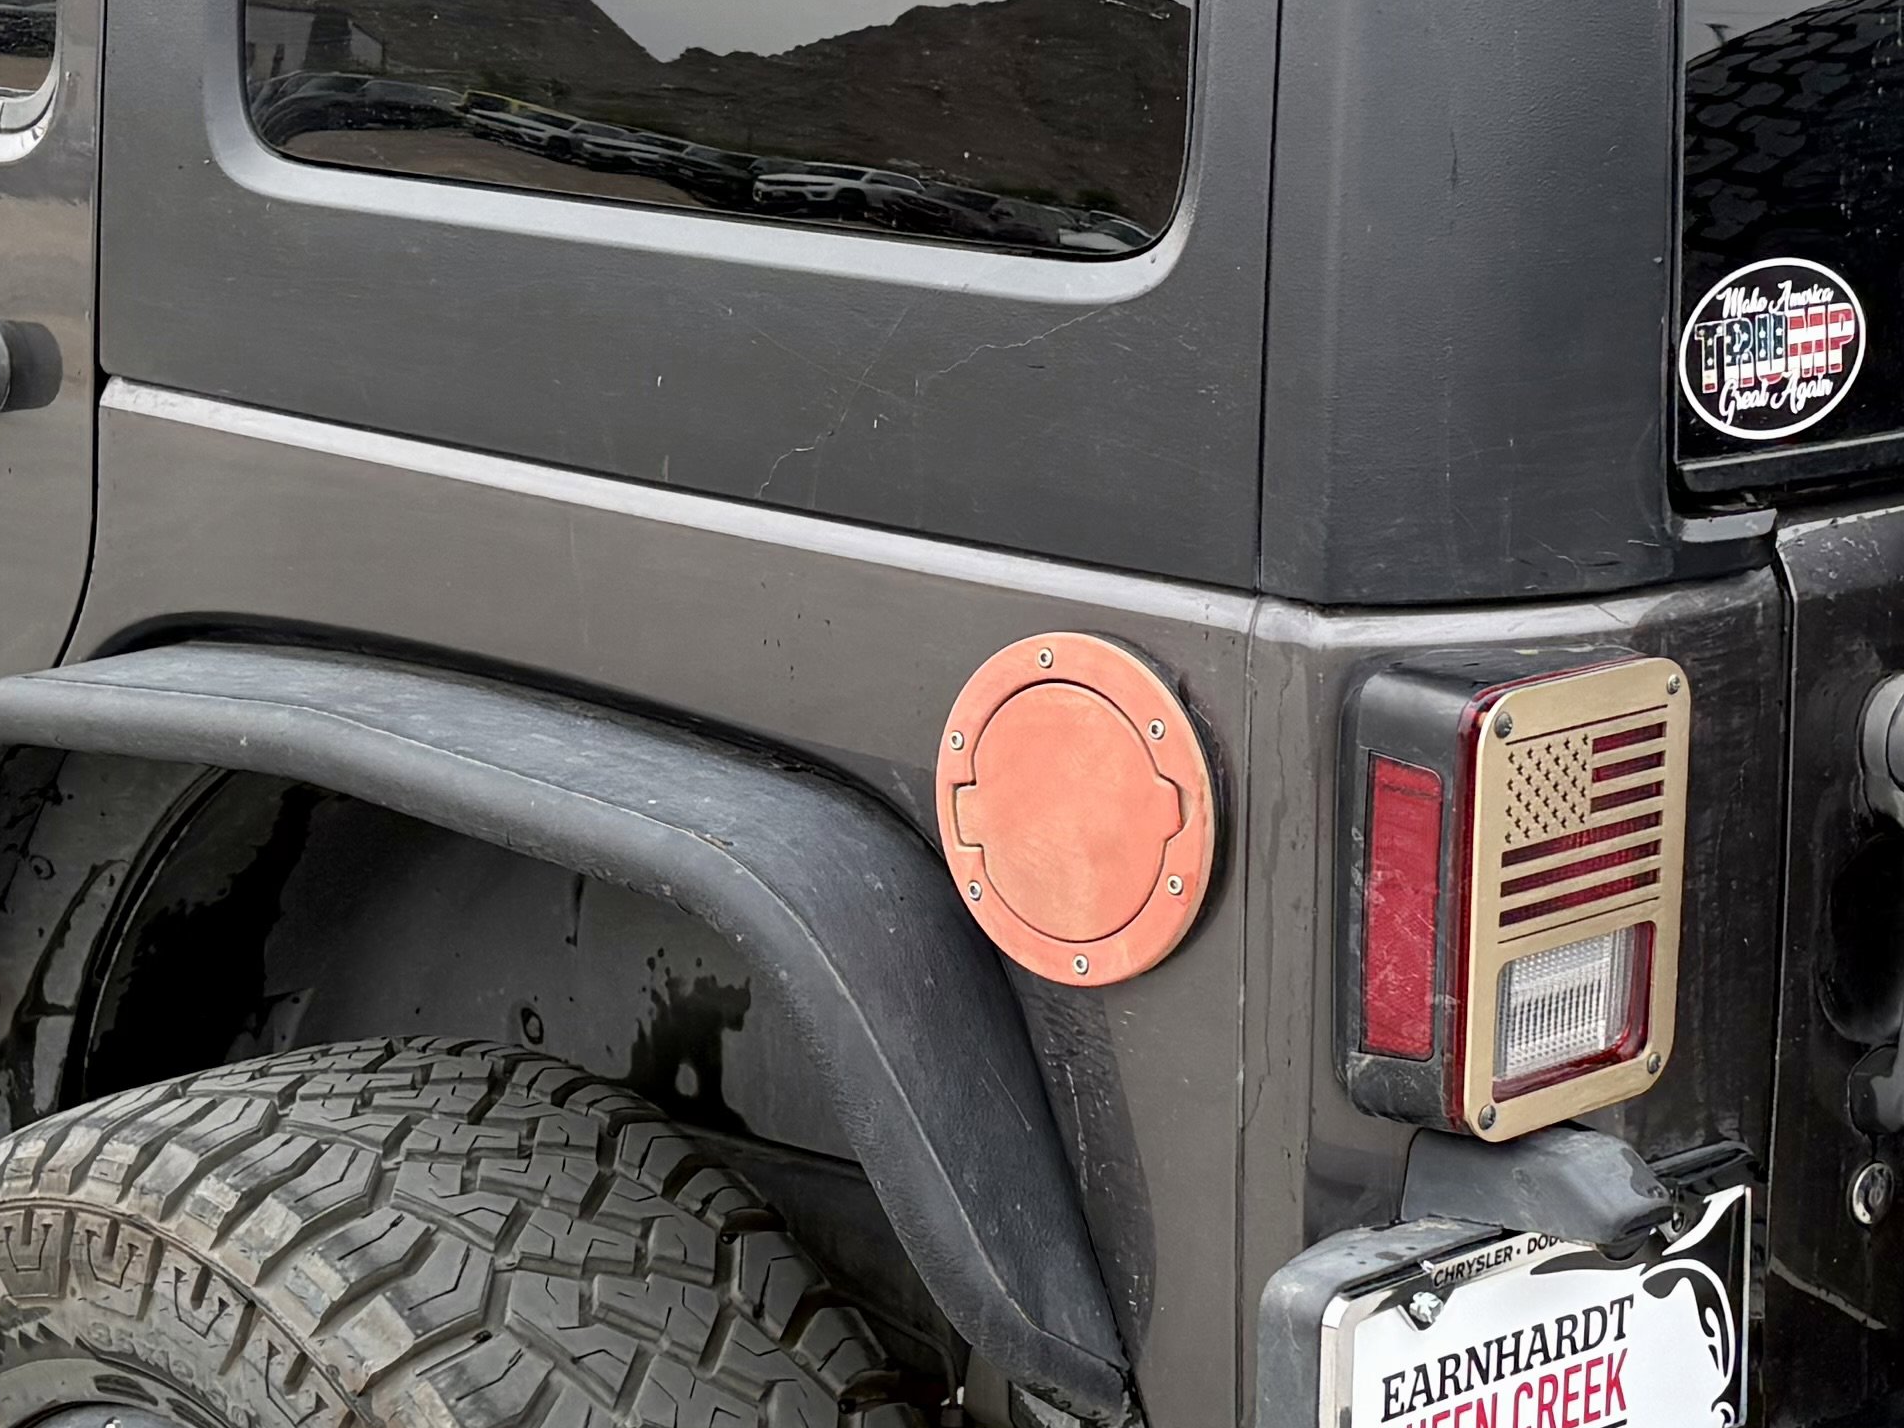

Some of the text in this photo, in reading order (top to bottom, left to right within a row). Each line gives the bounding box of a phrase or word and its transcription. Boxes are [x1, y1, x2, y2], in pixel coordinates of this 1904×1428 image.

[1695, 303, 1855, 393] TRUMP
[1719, 368, 1833, 427] Great Again
[1434, 1245, 1513, 1288] CHRYSLER
[1381, 1294, 1634, 1423] EARNHARDT
